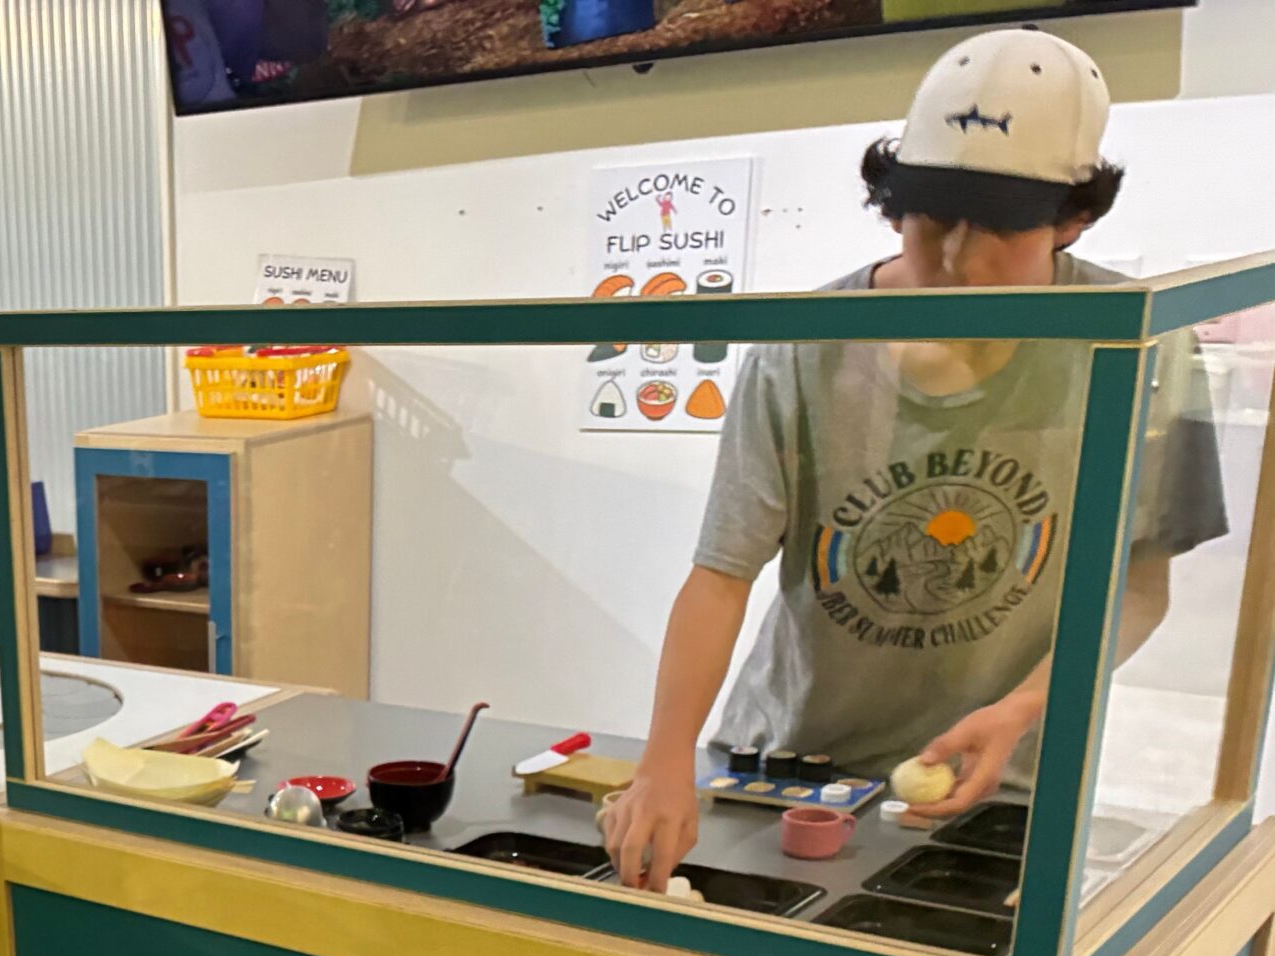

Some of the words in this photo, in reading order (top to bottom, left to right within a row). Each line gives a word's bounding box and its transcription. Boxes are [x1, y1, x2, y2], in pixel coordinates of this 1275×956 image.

[597, 174, 704, 222] WELCOME
[708, 186, 736, 216] TO
[606, 234, 650, 254] FLIP
[659, 230, 724, 250] SUSHI
[264, 265, 303, 280] SUSHI
[306, 268, 348, 284] MENU
[833, 461, 916, 527] CLUB
[927, 448, 1049, 516] BEYOND
[930, 584, 1029, 647] CHALLENGE
